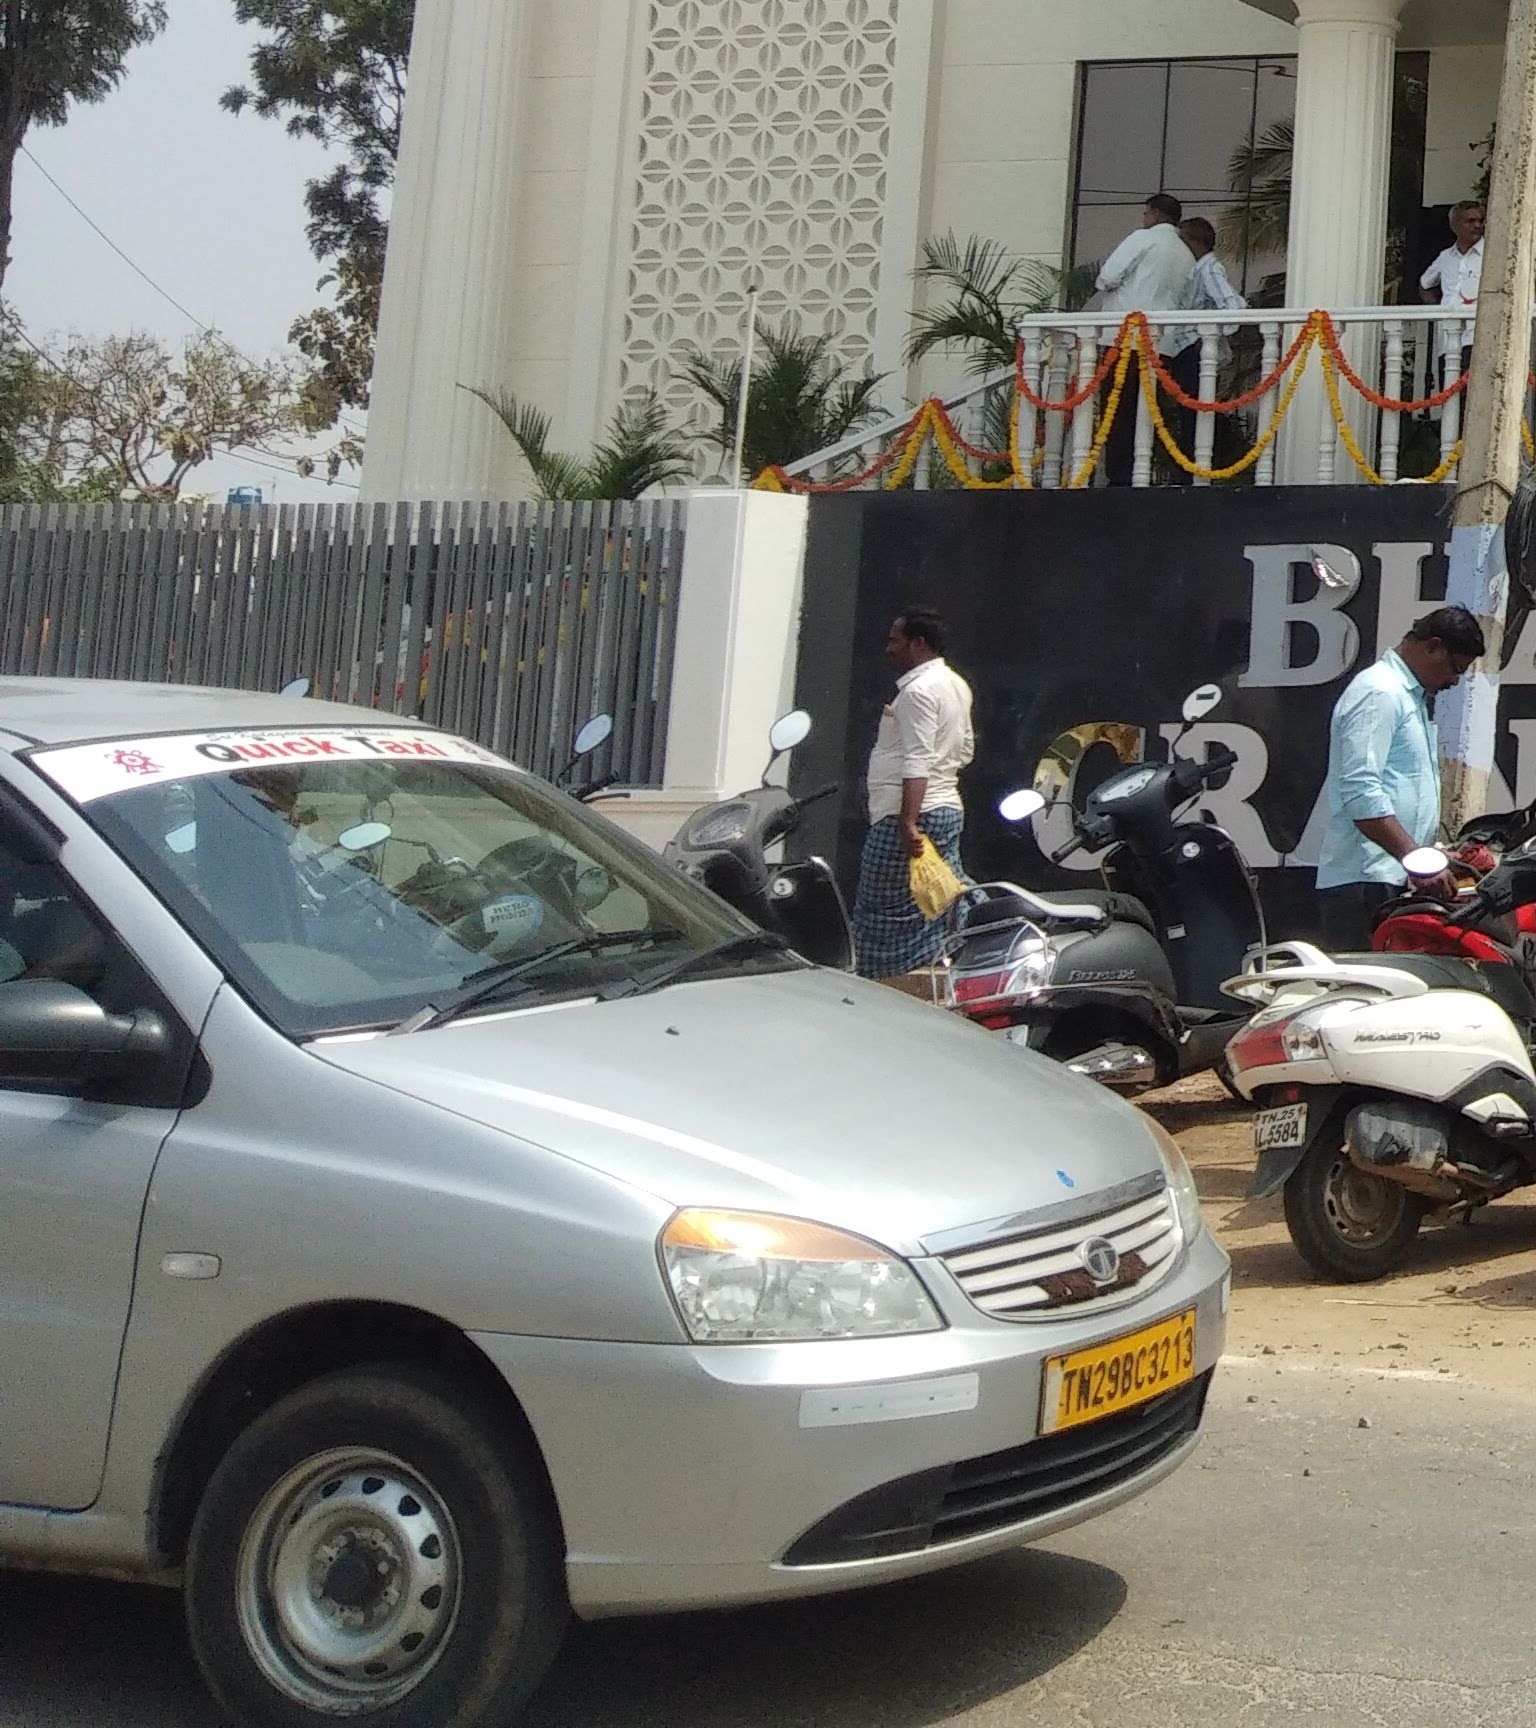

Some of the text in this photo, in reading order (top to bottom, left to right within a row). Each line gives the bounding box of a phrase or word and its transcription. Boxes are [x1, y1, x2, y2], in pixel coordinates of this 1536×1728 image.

[195, 736, 351, 762] Quick
[343, 736, 449, 757] Taxi
[1261, 1108, 1297, 1125] TN.25
[1063, 1325, 1193, 1417] TN29BC3213
